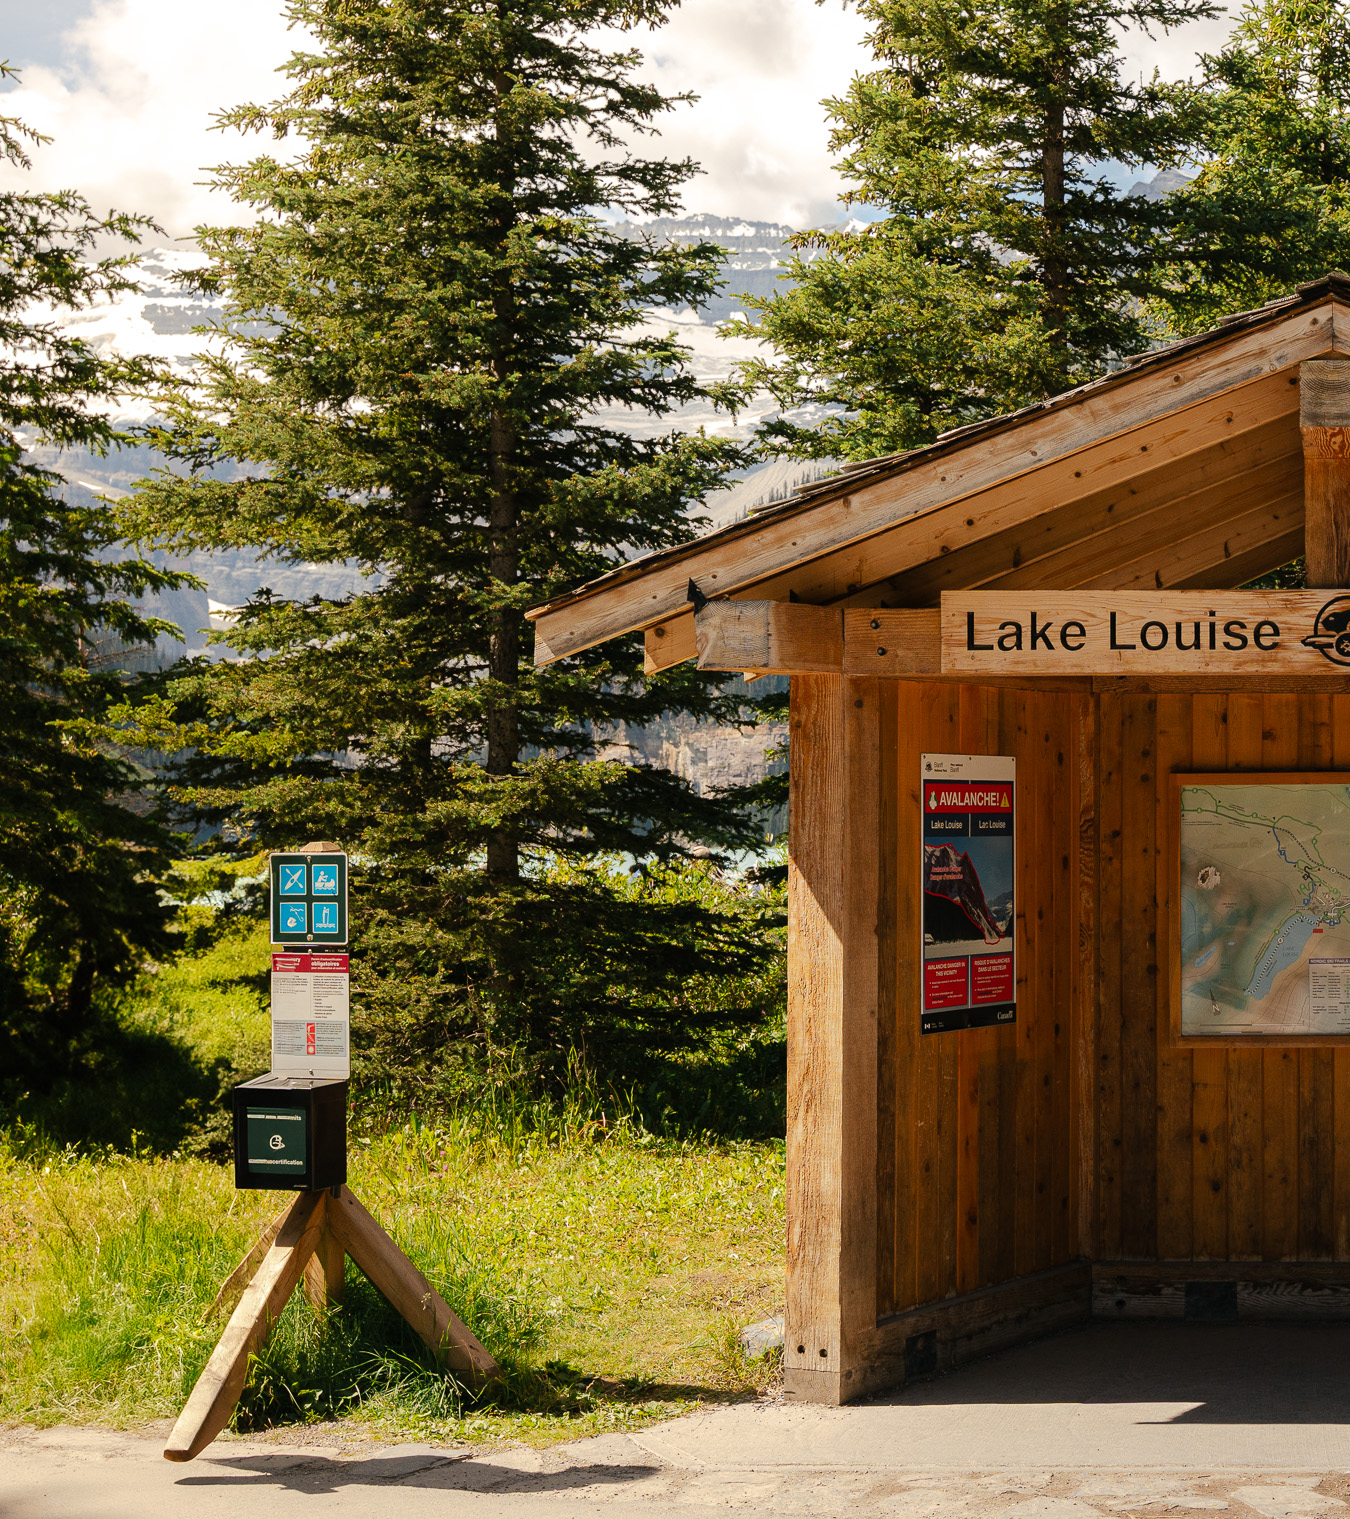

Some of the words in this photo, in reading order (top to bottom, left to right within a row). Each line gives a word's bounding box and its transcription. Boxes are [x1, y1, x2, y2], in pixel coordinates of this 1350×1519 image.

[967, 611, 1086, 652] Lake
[1110, 610, 1281, 652] Louise
[939, 791, 1000, 807] AVALANCHE!
[931, 820, 944, 829] Lake
[945, 820, 963, 829] Louise
[978, 820, 988, 829] Lac
[989, 820, 1006, 829] Louise
